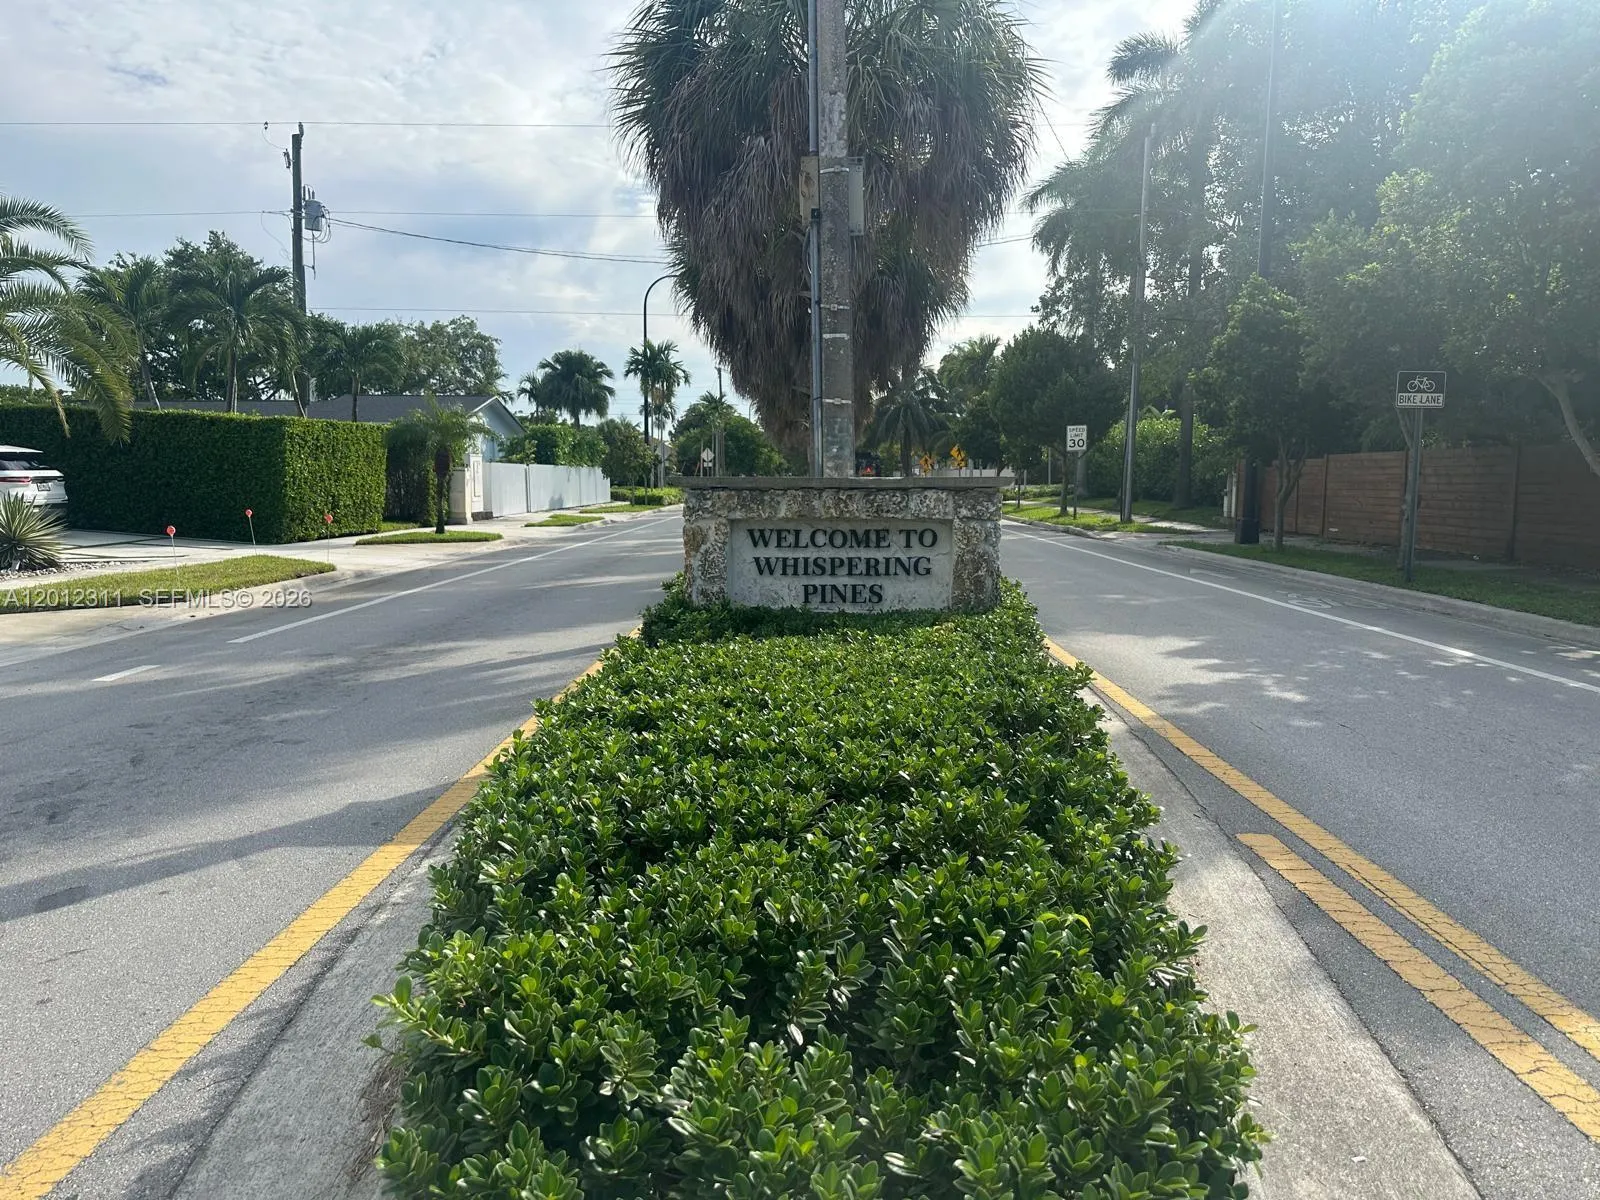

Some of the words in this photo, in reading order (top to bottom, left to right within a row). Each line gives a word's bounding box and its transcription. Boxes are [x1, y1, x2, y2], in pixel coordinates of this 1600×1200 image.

[1399, 394, 1417, 404] BIKE
[1419, 394, 1442, 404] LANE
[1068, 438, 1085, 448] 30
[747, 528, 891, 549] WELCOME
[899, 528, 938, 549] TO
[752, 556, 932, 576] WHISPERING
[801, 583, 883, 604] PINES
